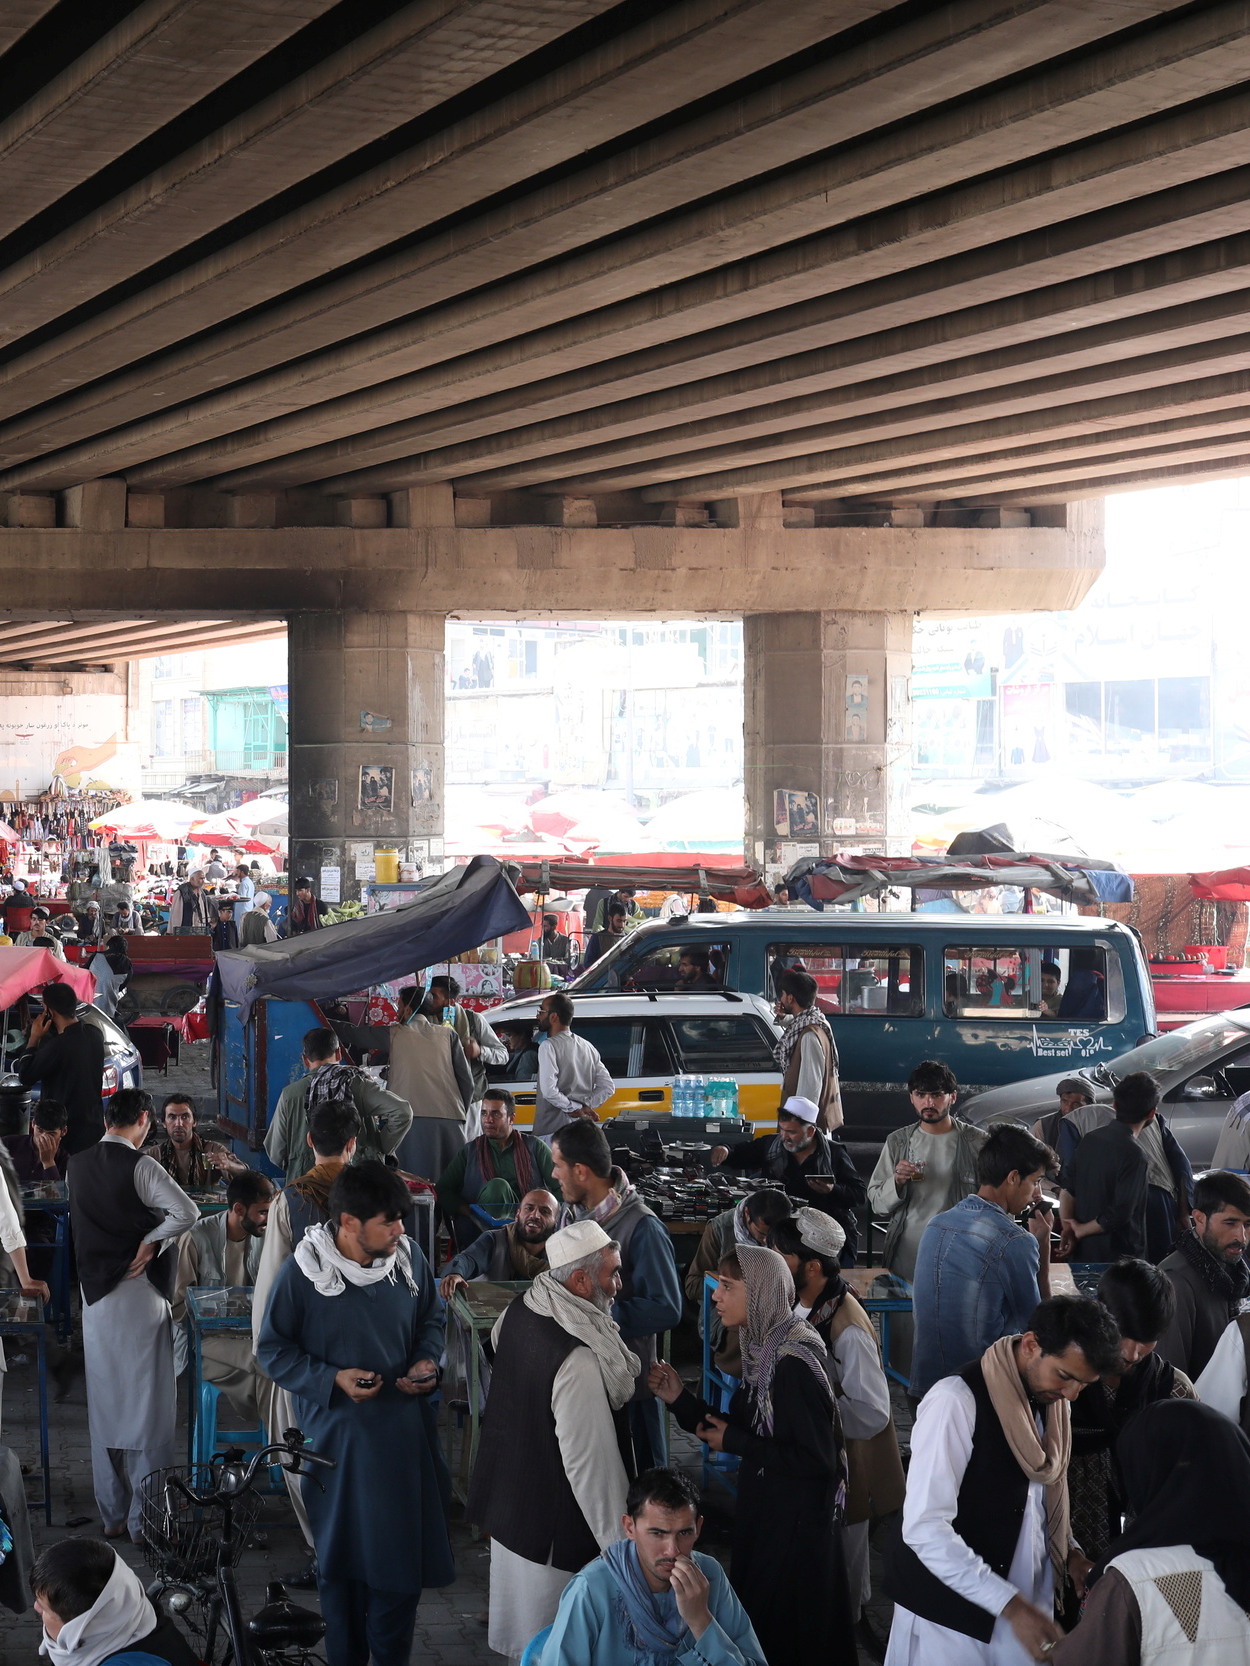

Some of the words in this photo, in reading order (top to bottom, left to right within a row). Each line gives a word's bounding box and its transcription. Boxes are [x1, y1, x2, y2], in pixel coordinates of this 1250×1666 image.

[1074, 624, 1134, 654] اسلام
[1141, 621, 1203, 650] جهان
[1068, 1028, 1090, 1037] TES
[1037, 1048, 1055, 1057] Best
[1056, 1048, 1069, 1057] set
